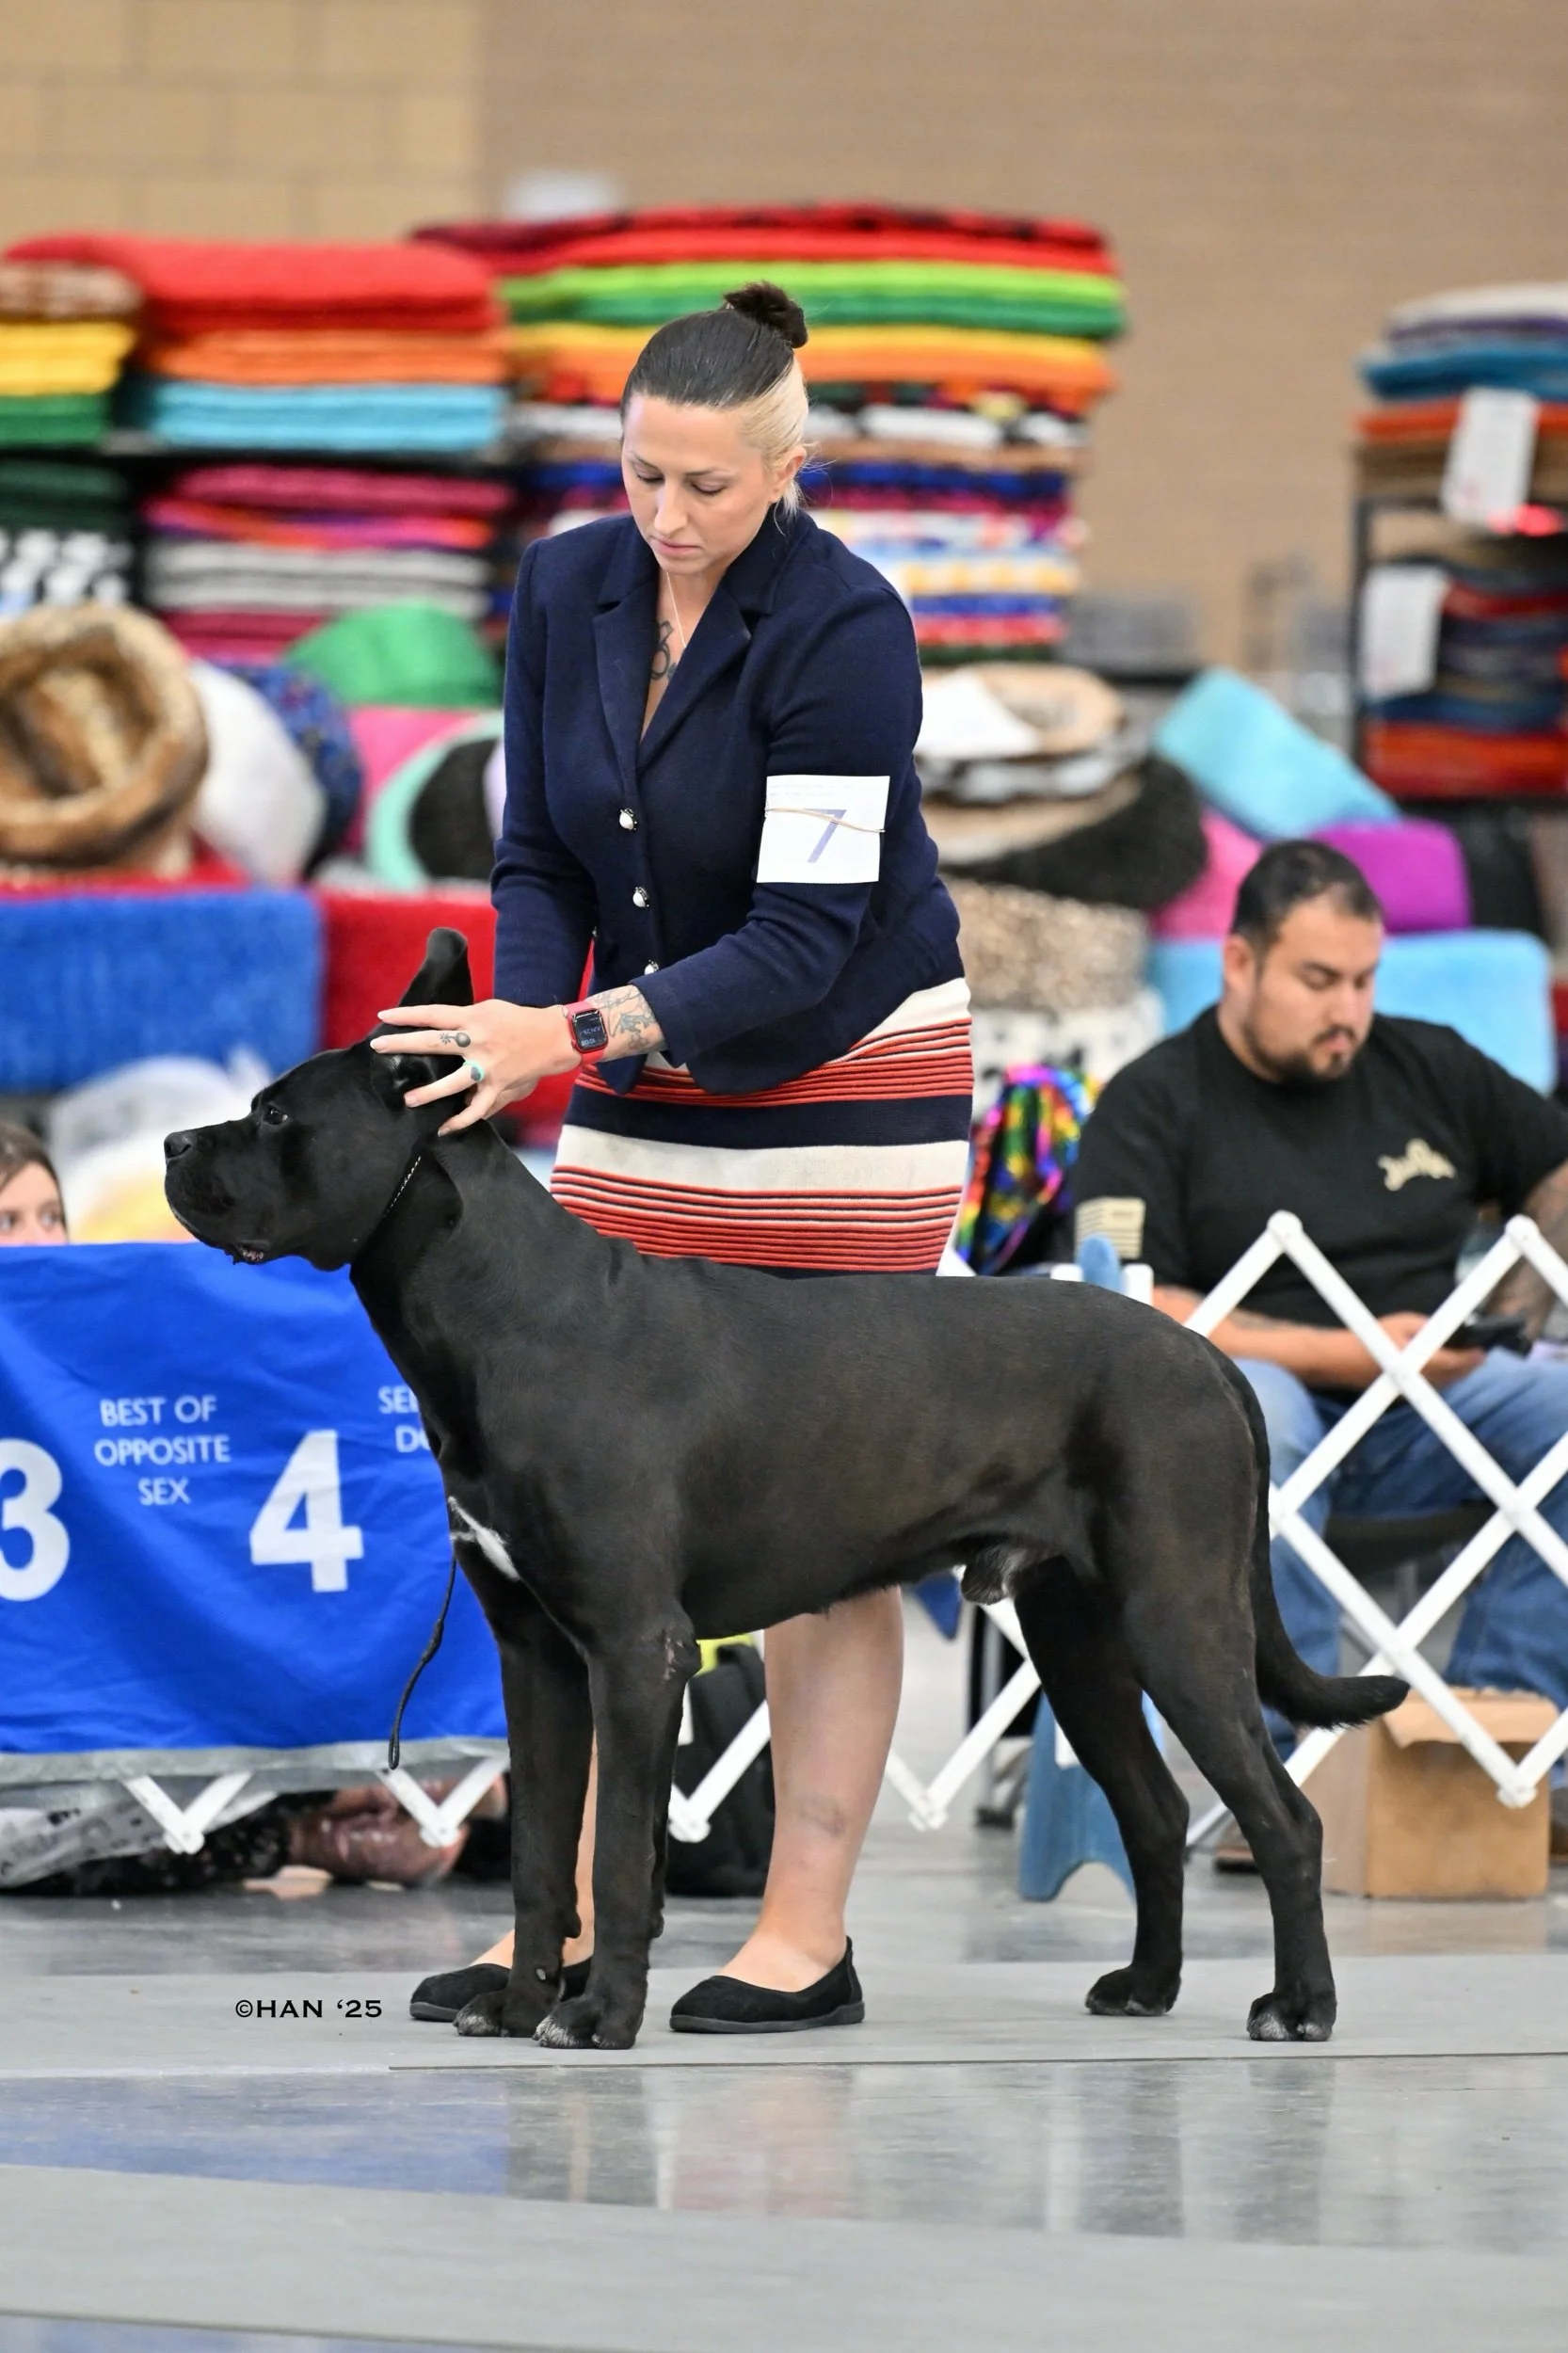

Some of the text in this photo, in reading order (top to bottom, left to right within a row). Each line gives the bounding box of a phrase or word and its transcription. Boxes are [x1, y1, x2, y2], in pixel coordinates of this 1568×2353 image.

[804, 808, 847, 863] 7
[100, 1395, 217, 1427] BEST OF
[94, 1434, 232, 1466] OPPOSITE
[138, 1477, 191, 1506] SEX
[249, 1429, 364, 1593] 4
[0, 1438, 71, 1601] 3
